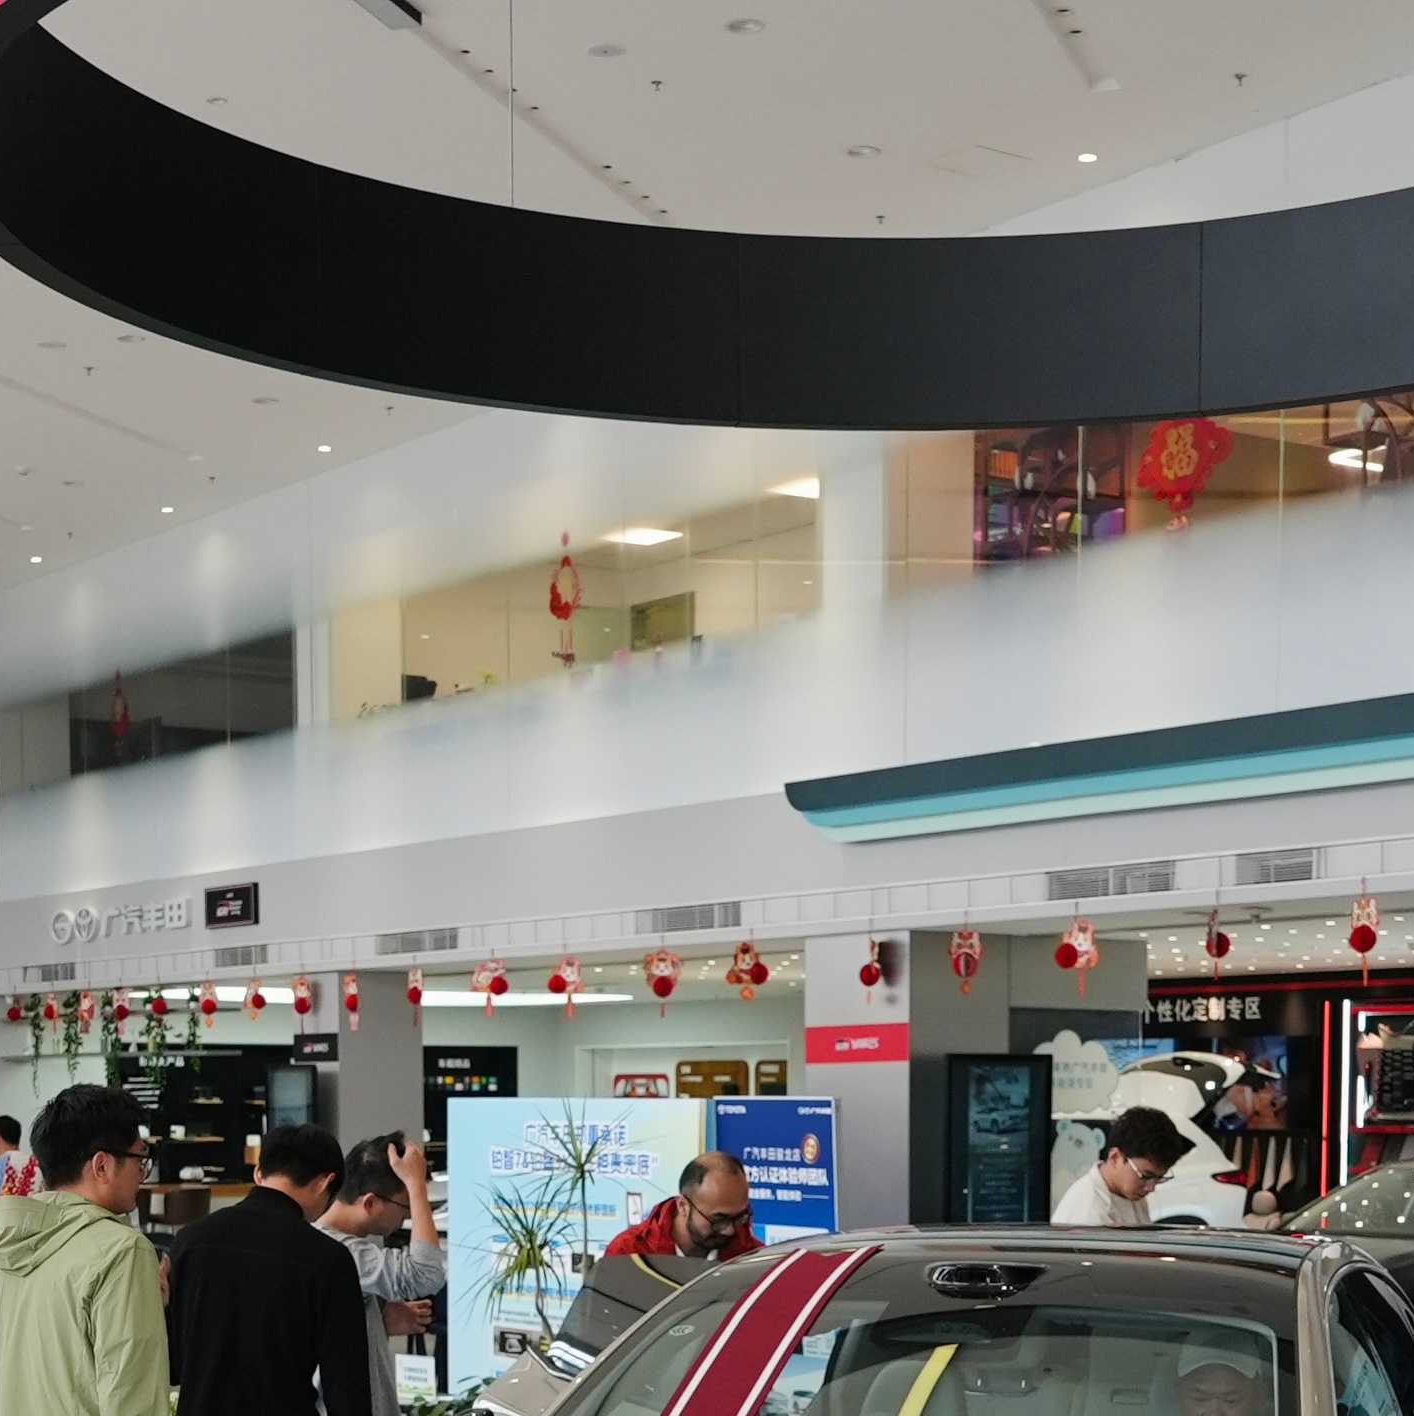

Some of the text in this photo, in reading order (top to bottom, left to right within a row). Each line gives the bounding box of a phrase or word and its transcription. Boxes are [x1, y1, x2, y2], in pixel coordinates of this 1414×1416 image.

[104, 899, 189, 938] 广汽丰田
[1142, 995, 1262, 1025] 个性化定制专区
